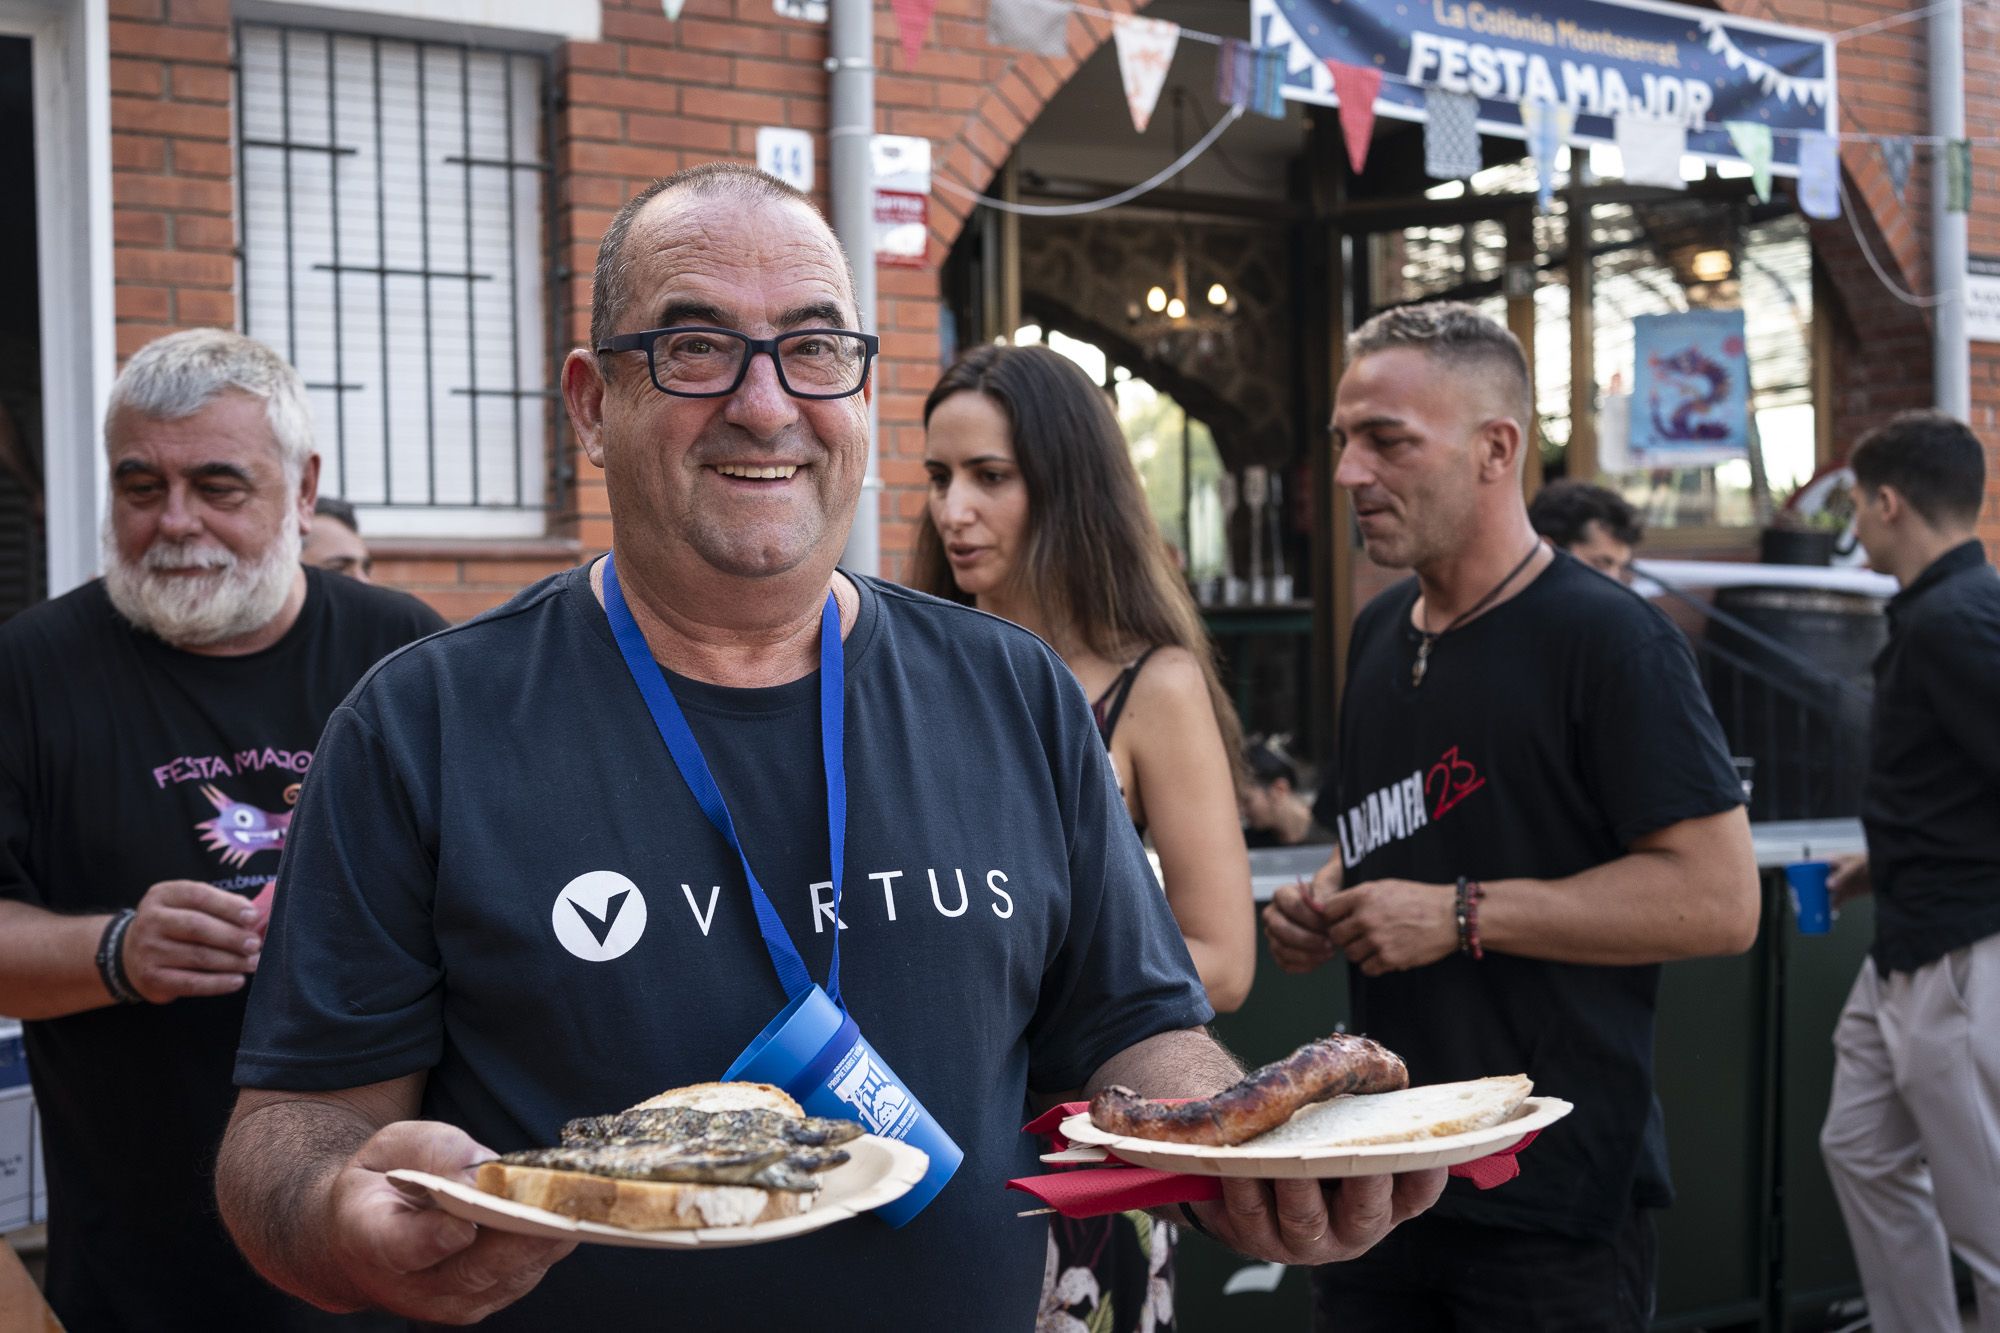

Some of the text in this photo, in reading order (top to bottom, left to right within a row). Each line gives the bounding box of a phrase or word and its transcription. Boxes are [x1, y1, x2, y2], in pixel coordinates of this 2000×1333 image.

[1433, 0, 1682, 68] La Colònia Montserrat
[1406, 30, 1713, 134] FESTA MAJOR
[152, 746, 313, 789] FESTA MAJO
[1425, 745, 1486, 820] 23
[680, 868, 1014, 937] VRTUS
